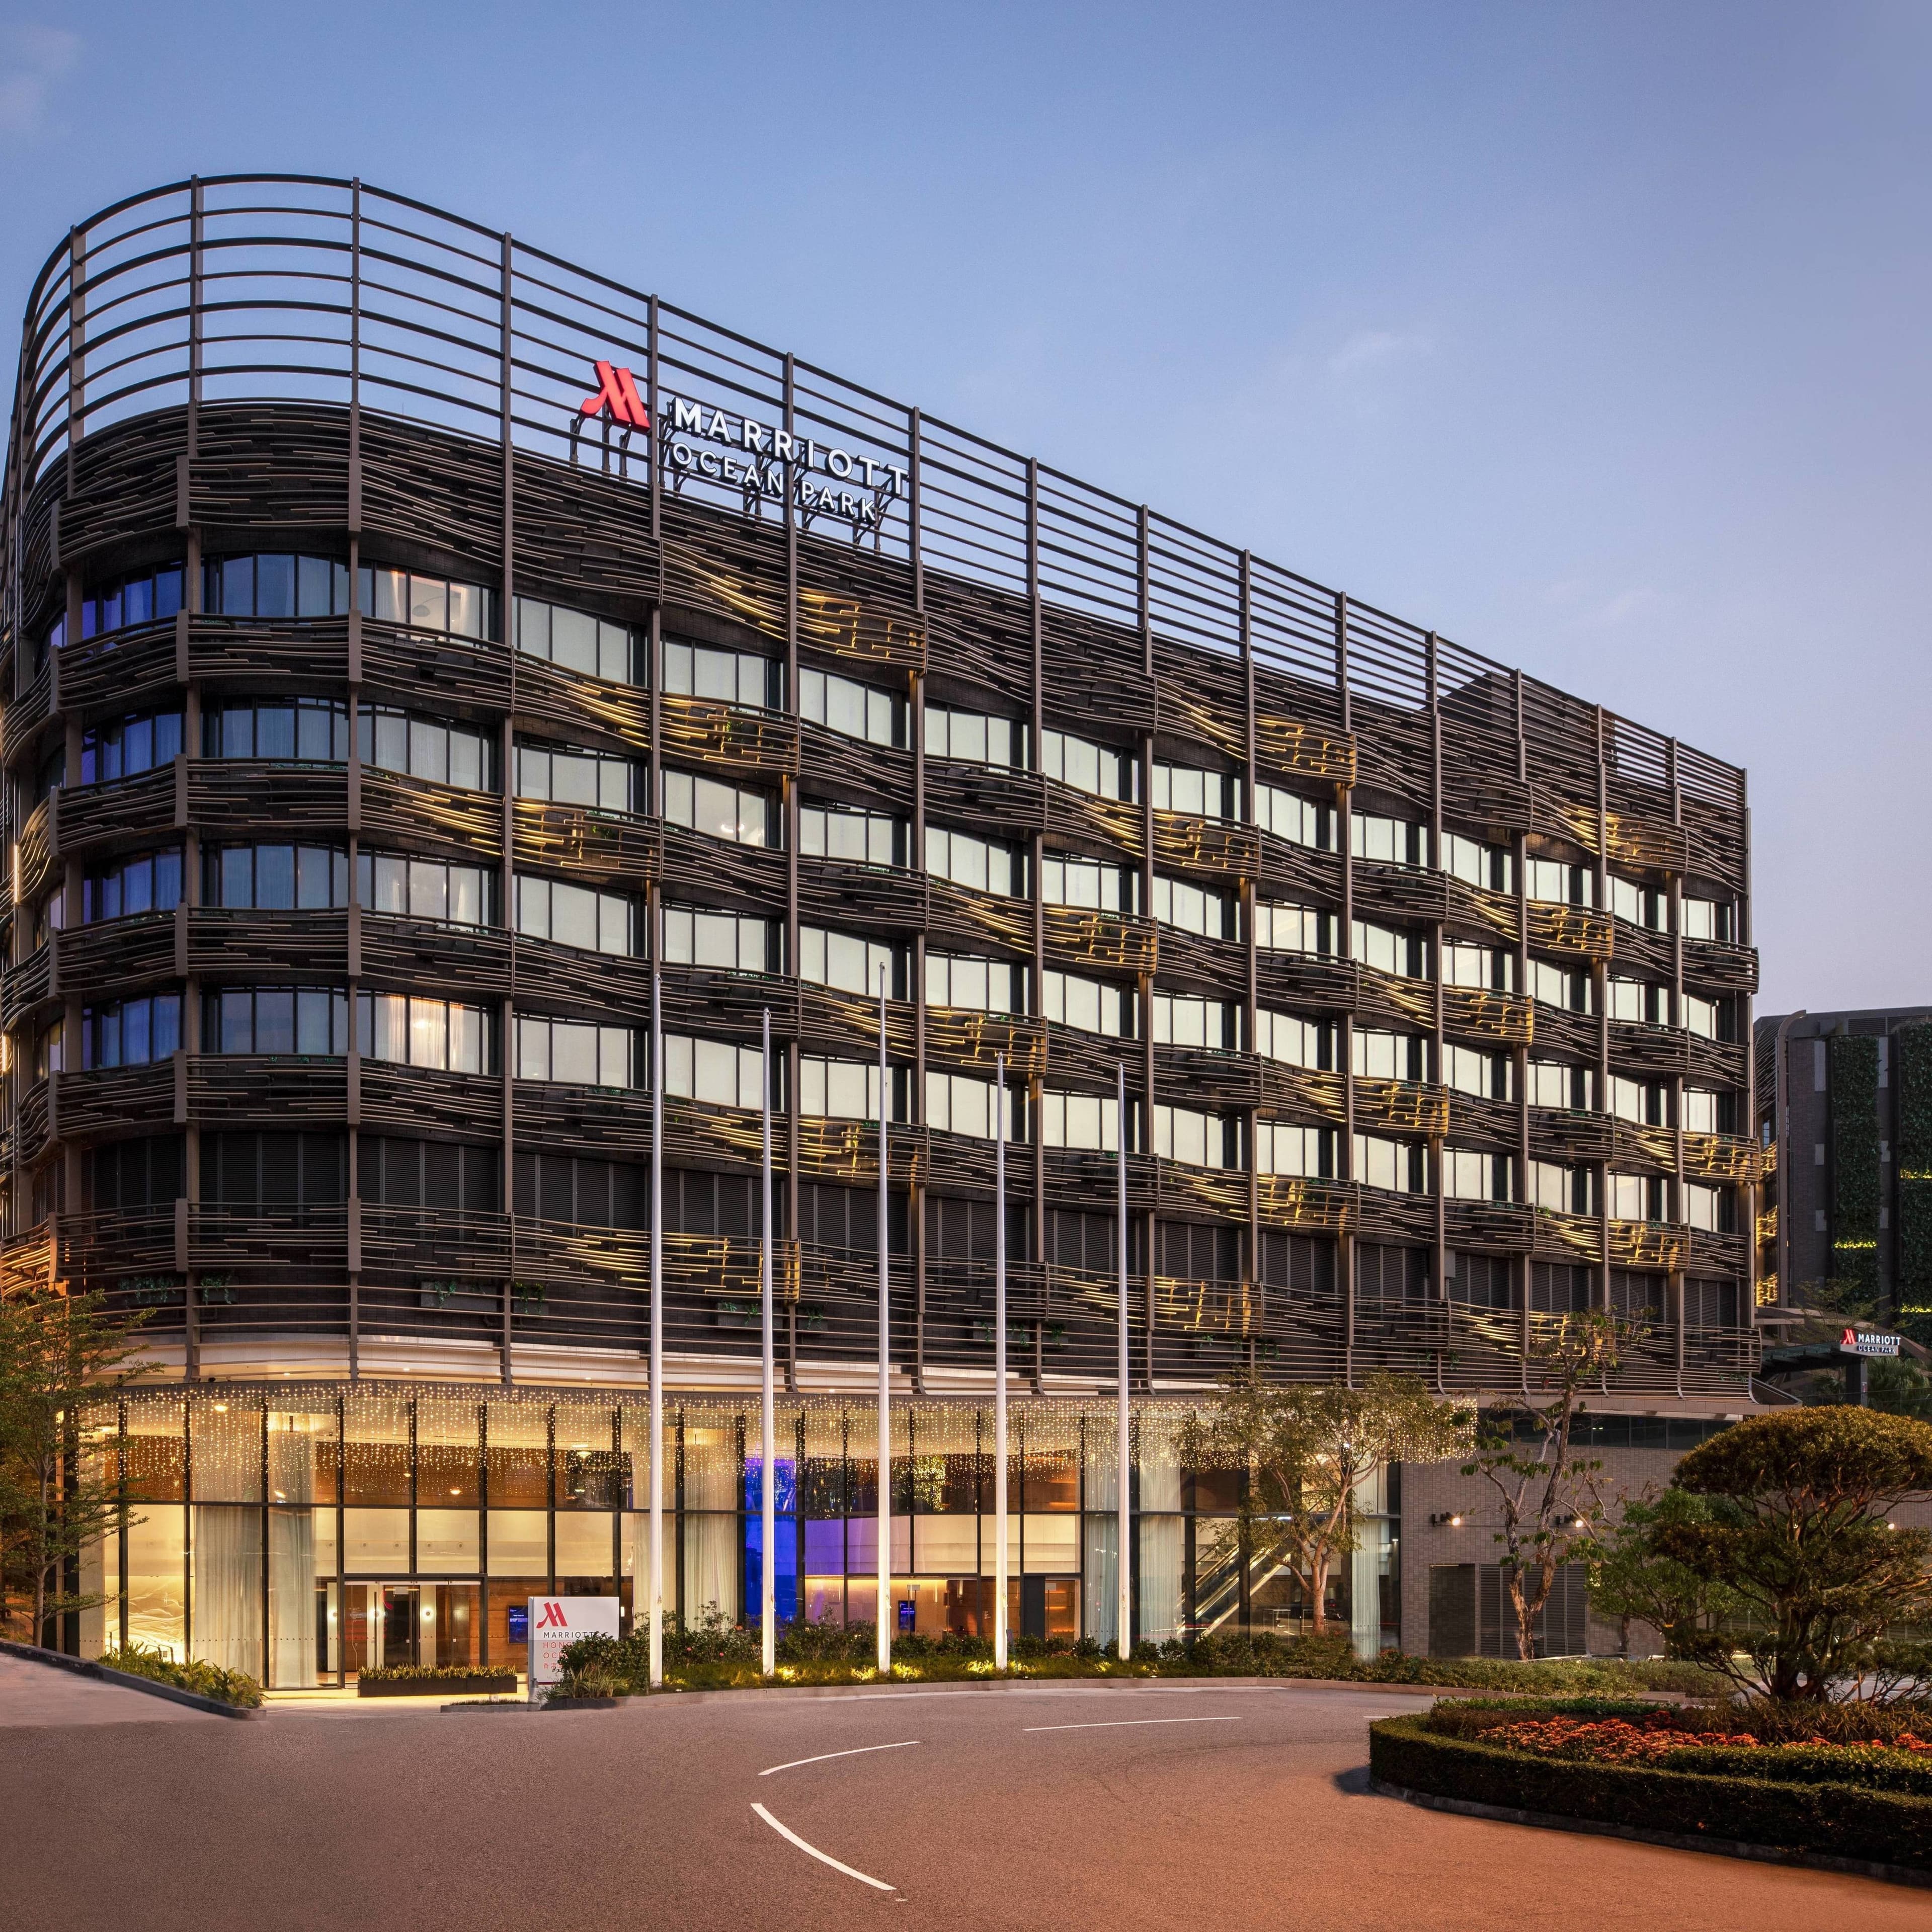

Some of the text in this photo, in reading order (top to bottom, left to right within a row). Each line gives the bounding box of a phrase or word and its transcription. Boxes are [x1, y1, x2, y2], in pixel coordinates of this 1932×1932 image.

[672, 442, 876, 524] OCEAN PARK
[673, 397, 908, 497] MARRIOTT
[1858, 1334, 1901, 1345] MARRIOTT
